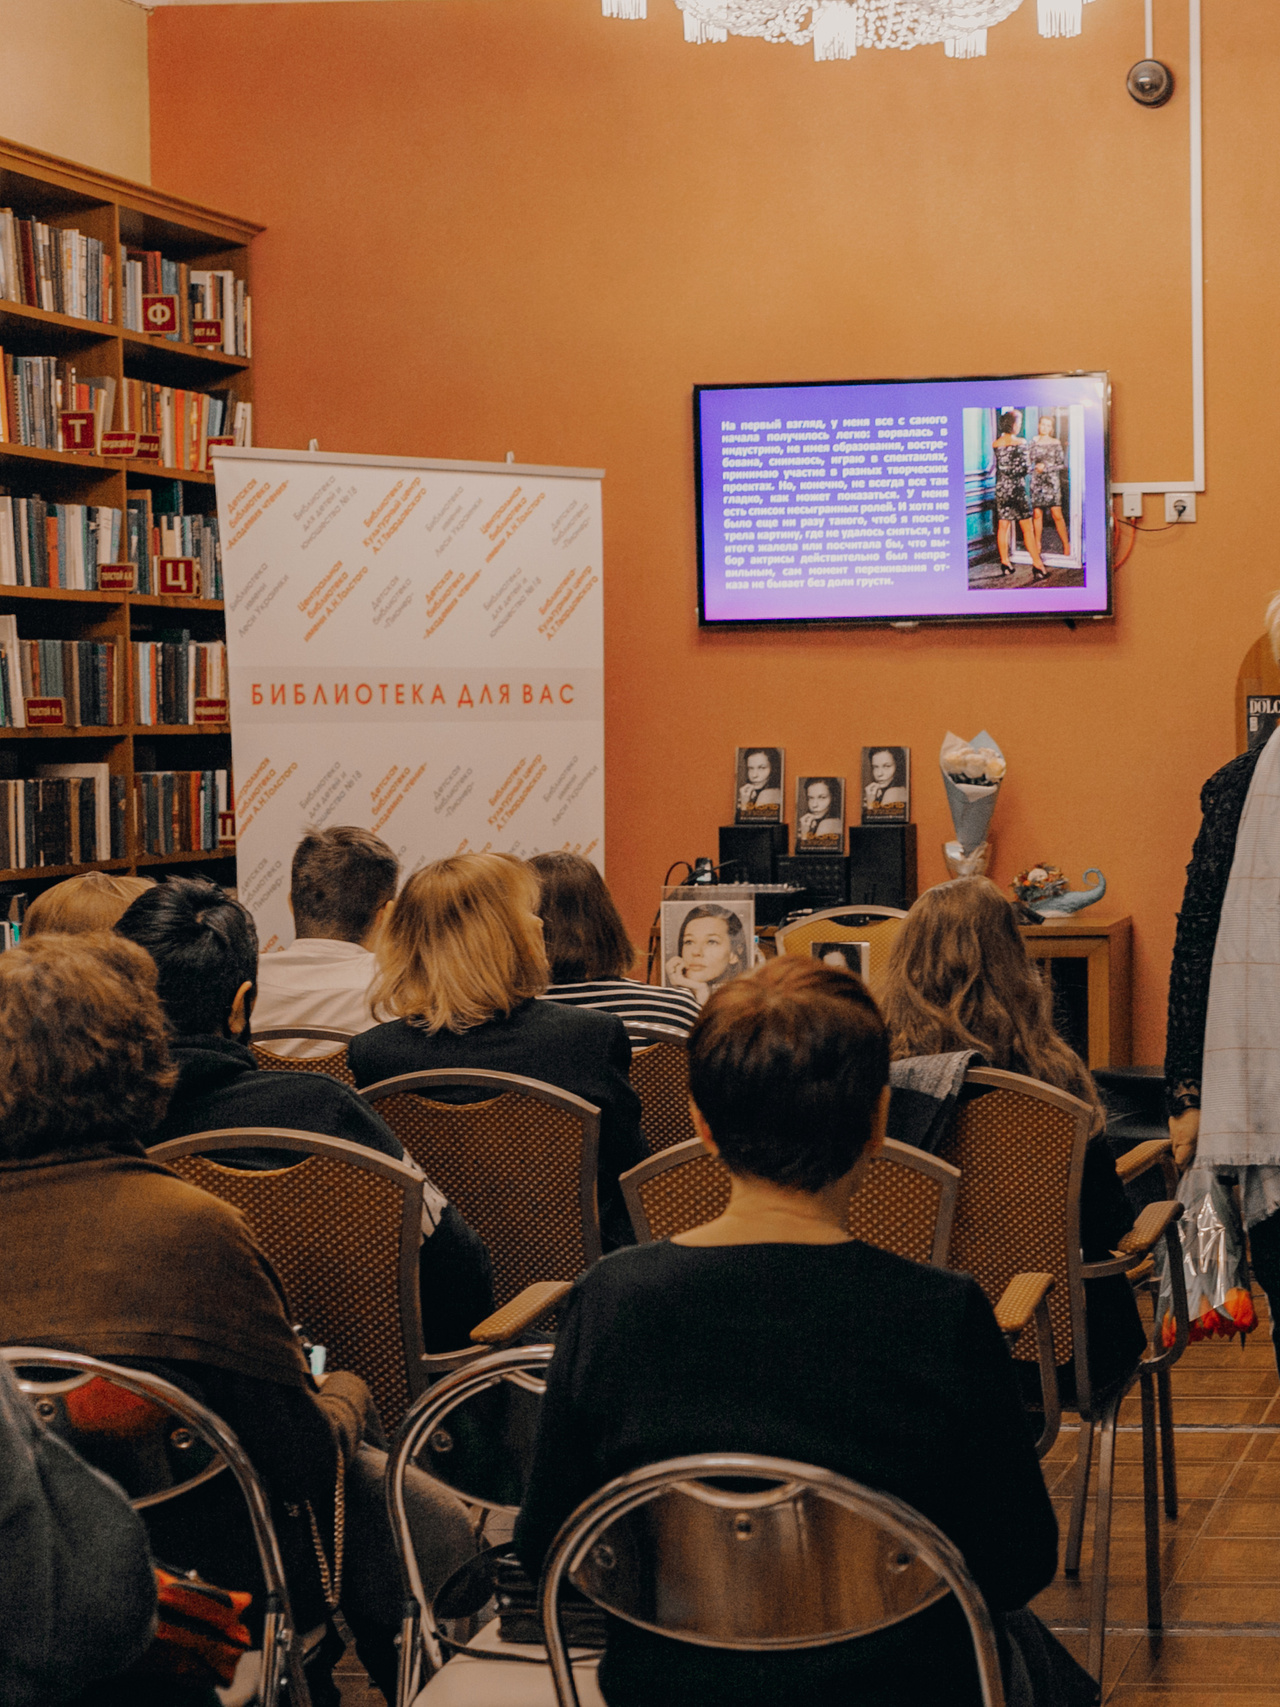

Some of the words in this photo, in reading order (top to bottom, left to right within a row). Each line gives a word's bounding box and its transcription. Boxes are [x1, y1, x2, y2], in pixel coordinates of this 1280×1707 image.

[147, 303, 170, 325] Ф
[68, 419, 87, 443] Т
[722, 420, 736, 430] На
[741, 418, 782, 432] первый
[831, 418, 838, 429] у
[843, 417, 870, 426] меня
[875, 416, 894, 425] все
[898, 416, 905, 425] с
[909, 415, 948, 424] самого
[722, 433, 760, 442] начала
[940, 427, 948, 436] в
[787, 444, 801, 453] не
[803, 443, 830, 452] имея
[831, 454, 866, 466] играю
[871, 454, 878, 462] в
[723, 469, 779, 481] принимаю
[783, 468, 826, 479] участие
[830, 467, 838, 476] в
[842, 466, 882, 477] разных
[852, 479, 866, 487] не
[869, 478, 905, 488] всегда
[908, 477, 927, 486] все
[930, 476, 949, 485] так
[770, 493, 789, 502] как
[796, 492, 831, 501] может
[907, 488, 915, 498] У
[922, 489, 949, 498] меня
[723, 507, 748, 516] есть
[748, 505, 786, 515] список
[898, 500, 907, 511] И
[909, 501, 934, 510] хотя
[936, 501, 950, 510] не
[724, 517, 753, 528] было
[756, 518, 779, 528] еще
[782, 517, 796, 526] ни
[800, 517, 825, 528] разу
[872, 513, 897, 524] чтоб
[901, 514, 908, 523] я
[724, 531, 755, 542] трела
[805, 529, 824, 539] где
[826, 529, 840, 537] не
[841, 527, 885, 539] удалось
[934, 526, 941, 534] и
[943, 526, 951, 534] в
[724, 543, 755, 552] итоге
[758, 542, 799, 551] жалела
[802, 541, 823, 550] или
[908, 539, 927, 547] что
[725, 554, 745, 566] бор
[750, 554, 795, 566] актрисы
[886, 550, 908, 560] был
[166, 563, 187, 591] Ц
[782, 566, 802, 575] сам
[809, 565, 848, 575] момент
[726, 580, 750, 589] каза
[752, 579, 765, 588] не
[766, 577, 805, 588] бывает
[807, 576, 826, 587] без
[827, 577, 854, 588] доли
[252, 683, 446, 705] БИБЛИОТЕКА
[458, 684, 510, 709] ДЛЯ
[523, 684, 575, 705] ВАС
